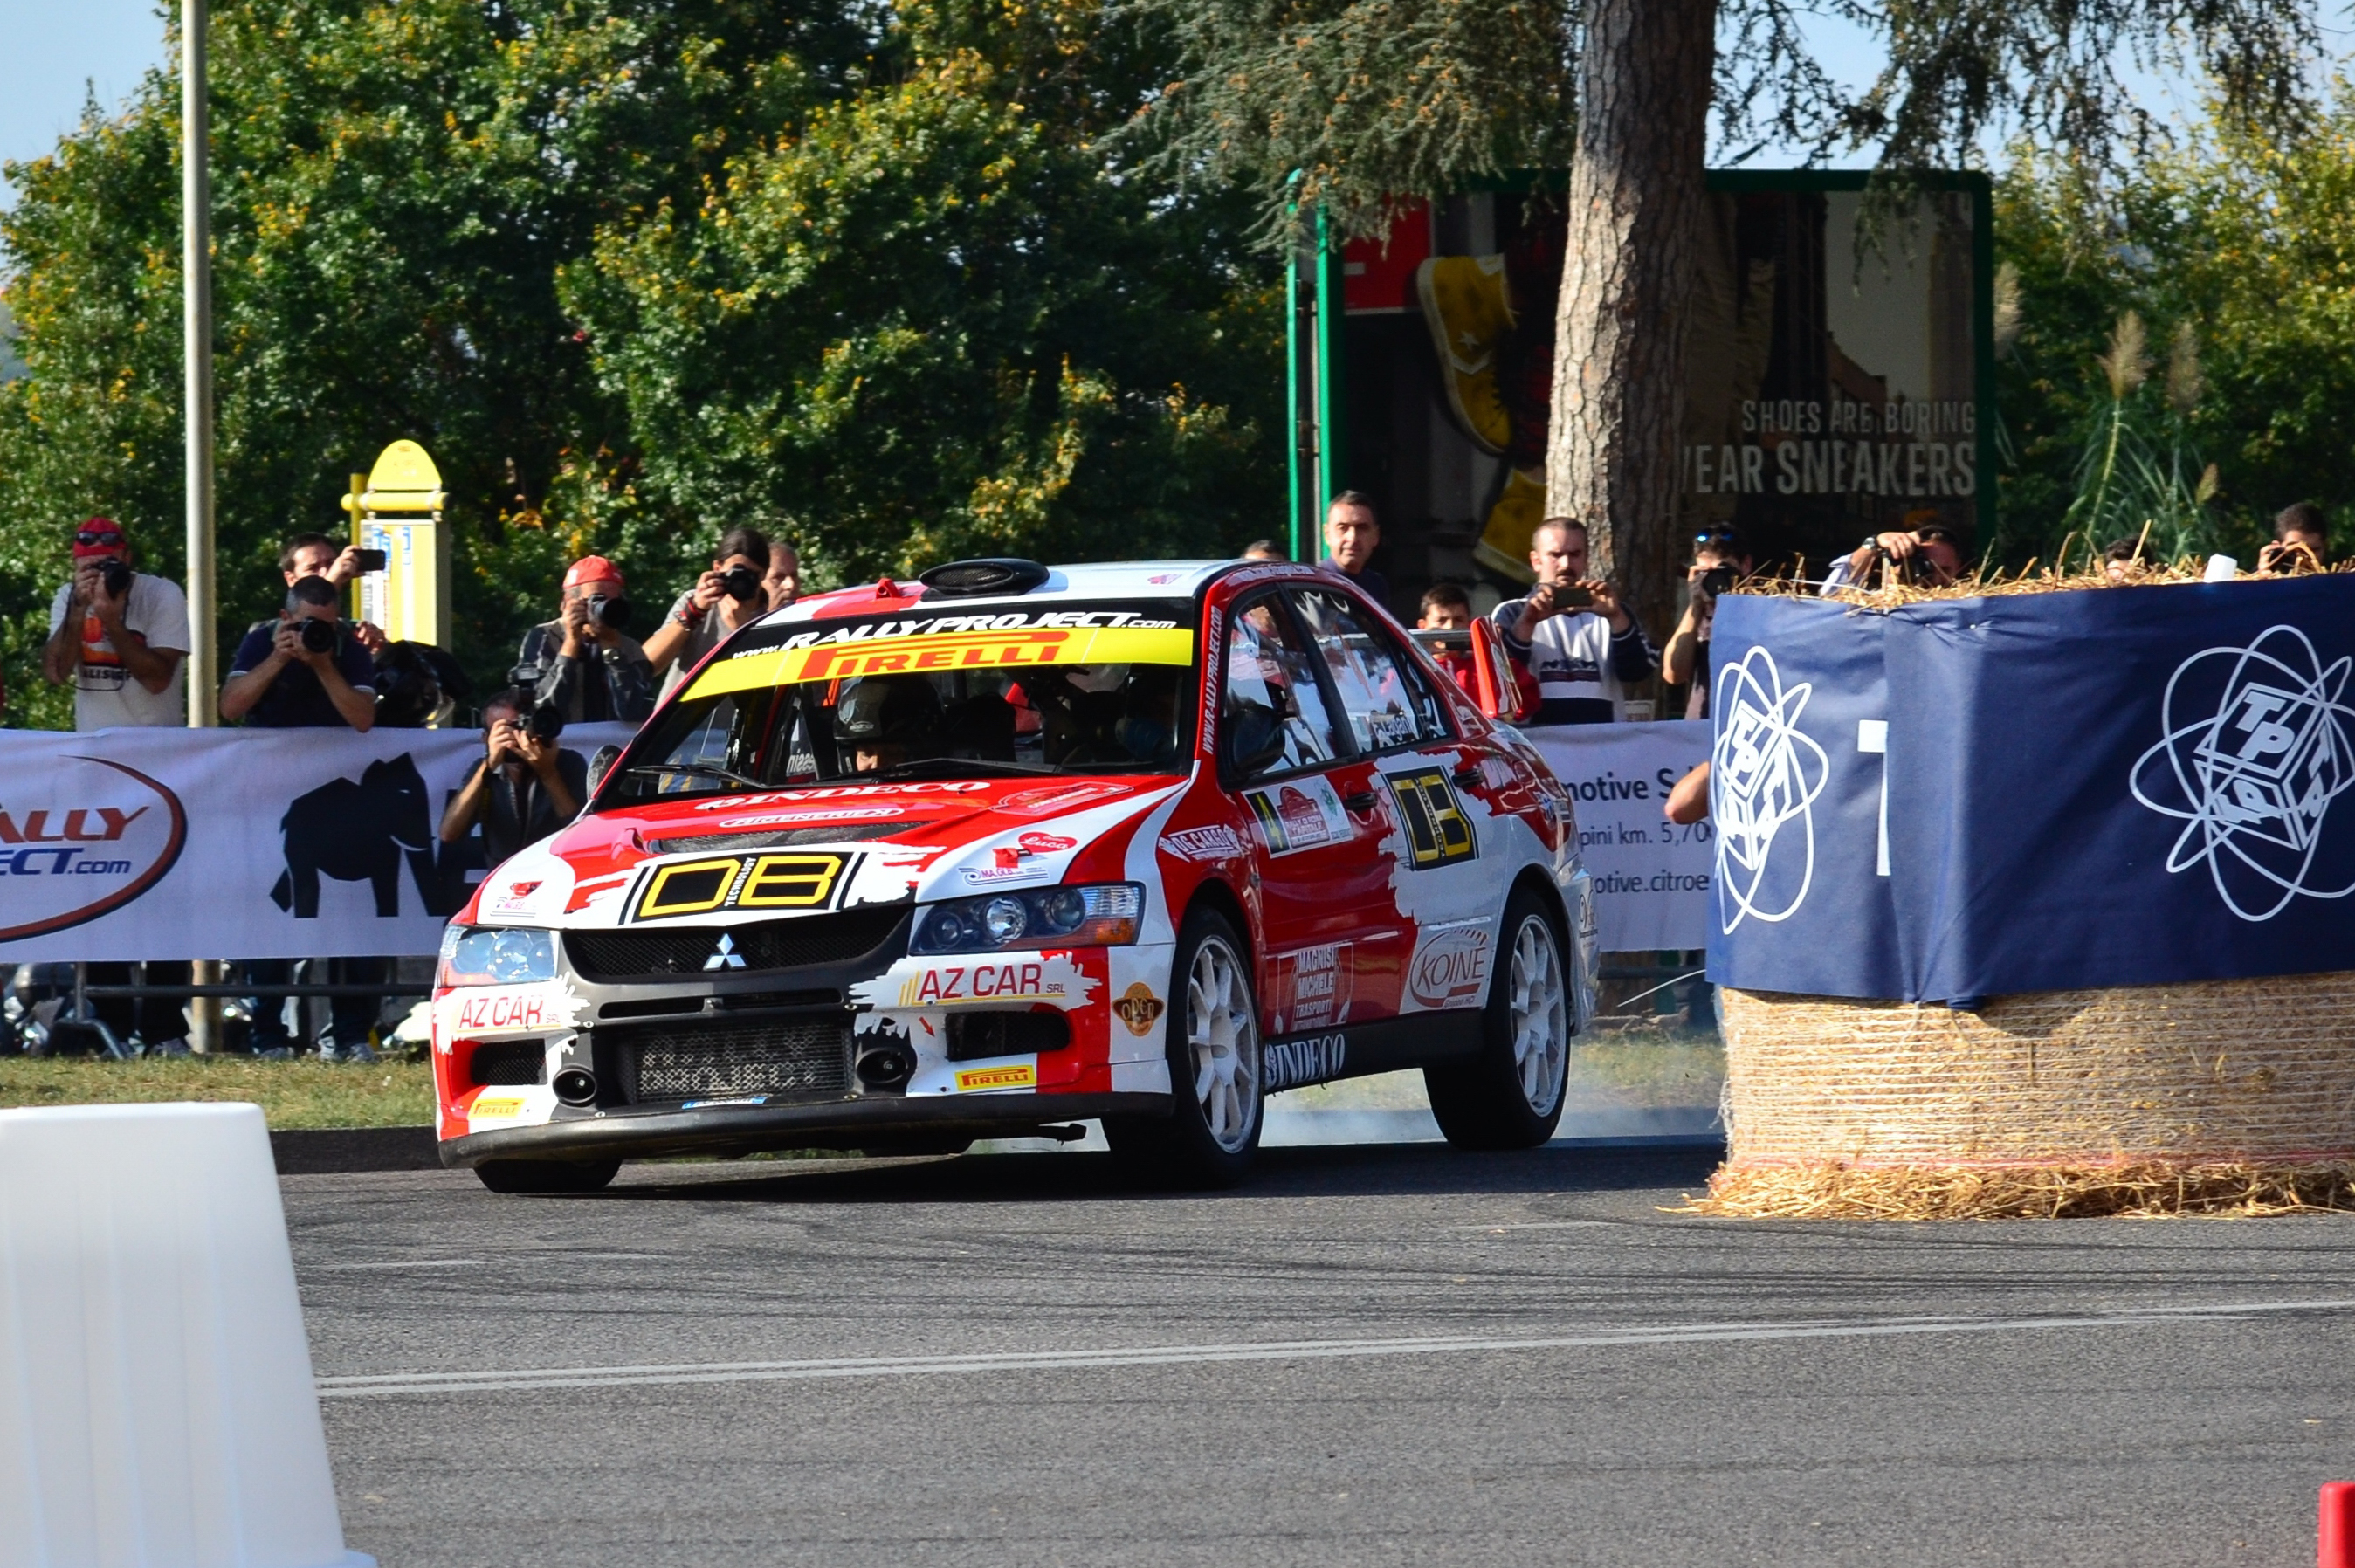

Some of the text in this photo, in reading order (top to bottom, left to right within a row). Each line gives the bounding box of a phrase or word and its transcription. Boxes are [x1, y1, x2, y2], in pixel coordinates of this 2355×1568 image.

[1741, 400, 1975, 434] SHOES ARE BORING
[1776, 441, 1976, 496] SNEAKERS
[797, 630, 1070, 681] PIRELLI
[739, 781, 991, 804] INDECO
[1020, 837, 1069, 849] Luca
[1189, 829, 1230, 849] CARGO
[1618, 822, 1653, 844] km.
[724, 856, 757, 907] TECHNOLOGY
[919, 963, 1066, 1001] AZ CAR SRL
[1298, 971, 1334, 1000] MICHELE
[458, 997, 489, 1028] AZ
[492, 996, 544, 1027] CAR
[961, 1068, 1029, 1087] PIRELLI
[473, 1101, 519, 1115] PIRELLI
